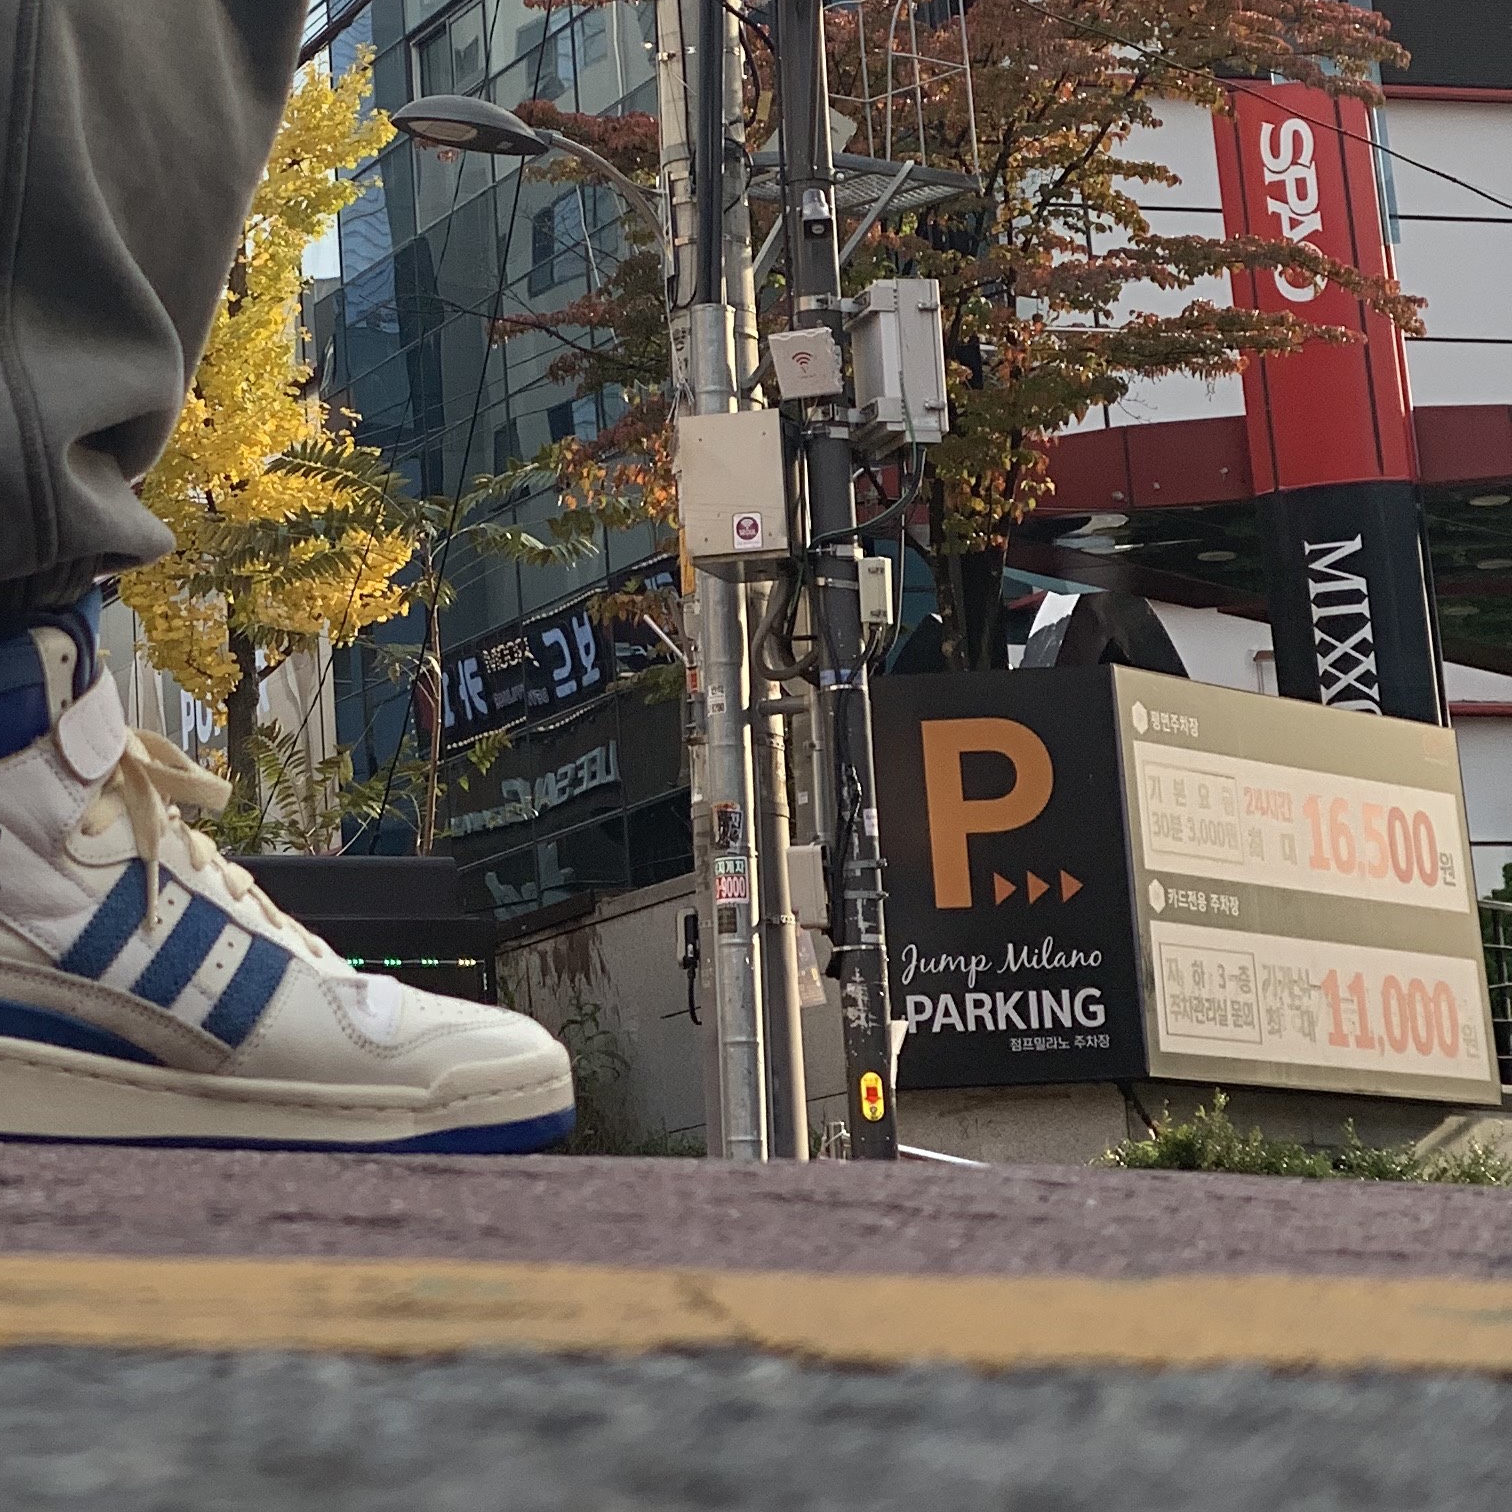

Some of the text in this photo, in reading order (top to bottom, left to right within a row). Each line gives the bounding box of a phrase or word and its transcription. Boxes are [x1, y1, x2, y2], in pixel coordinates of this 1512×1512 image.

[1303, 533, 1383, 717] MIXX
[1150, 710, 1200, 738] 평면주차장
[920, 717, 1055, 910] P
[1210, 893, 1240, 918] 주차장
[900, 934, 1103, 988] Jump Milano
[905, 986, 1107, 1035] PARKING
[1074, 1033, 1110, 1048] 주차장
